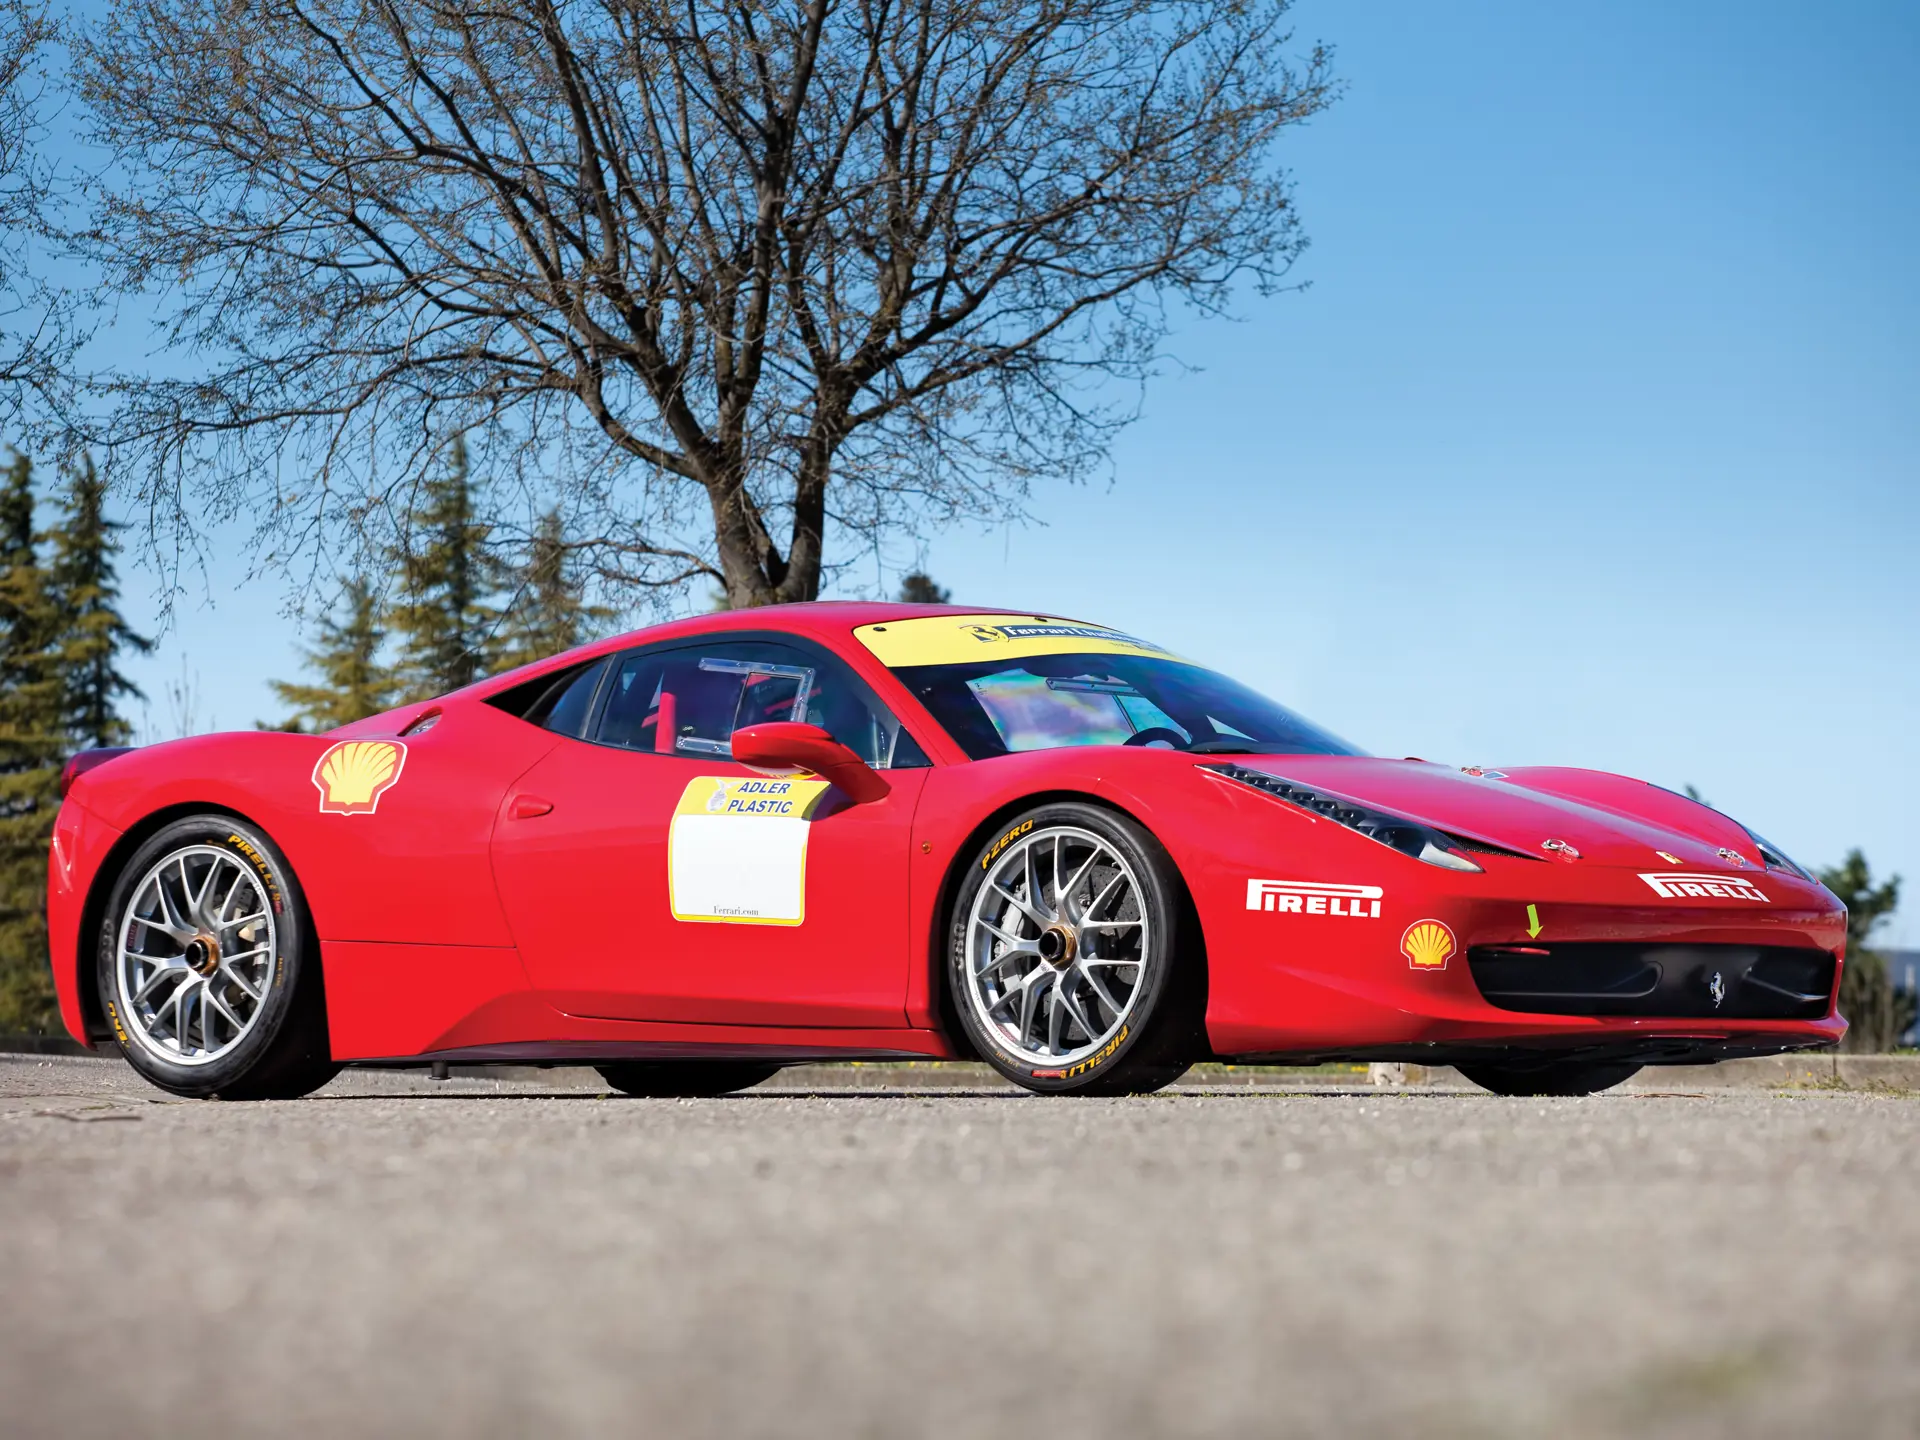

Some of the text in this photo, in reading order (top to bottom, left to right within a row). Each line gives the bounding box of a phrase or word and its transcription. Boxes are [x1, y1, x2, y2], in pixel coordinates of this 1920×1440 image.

[1004, 625, 1072, 636] Ferrari
[737, 781, 791, 795] ADLER
[727, 799, 793, 814] PLASTIC
[1636, 872, 1771, 903] PIRELLI
[1246, 878, 1384, 918] PIRELLI
[713, 905, 759, 916] Ferrari.com
[1069, 1024, 1130, 1079] PIRELLI
